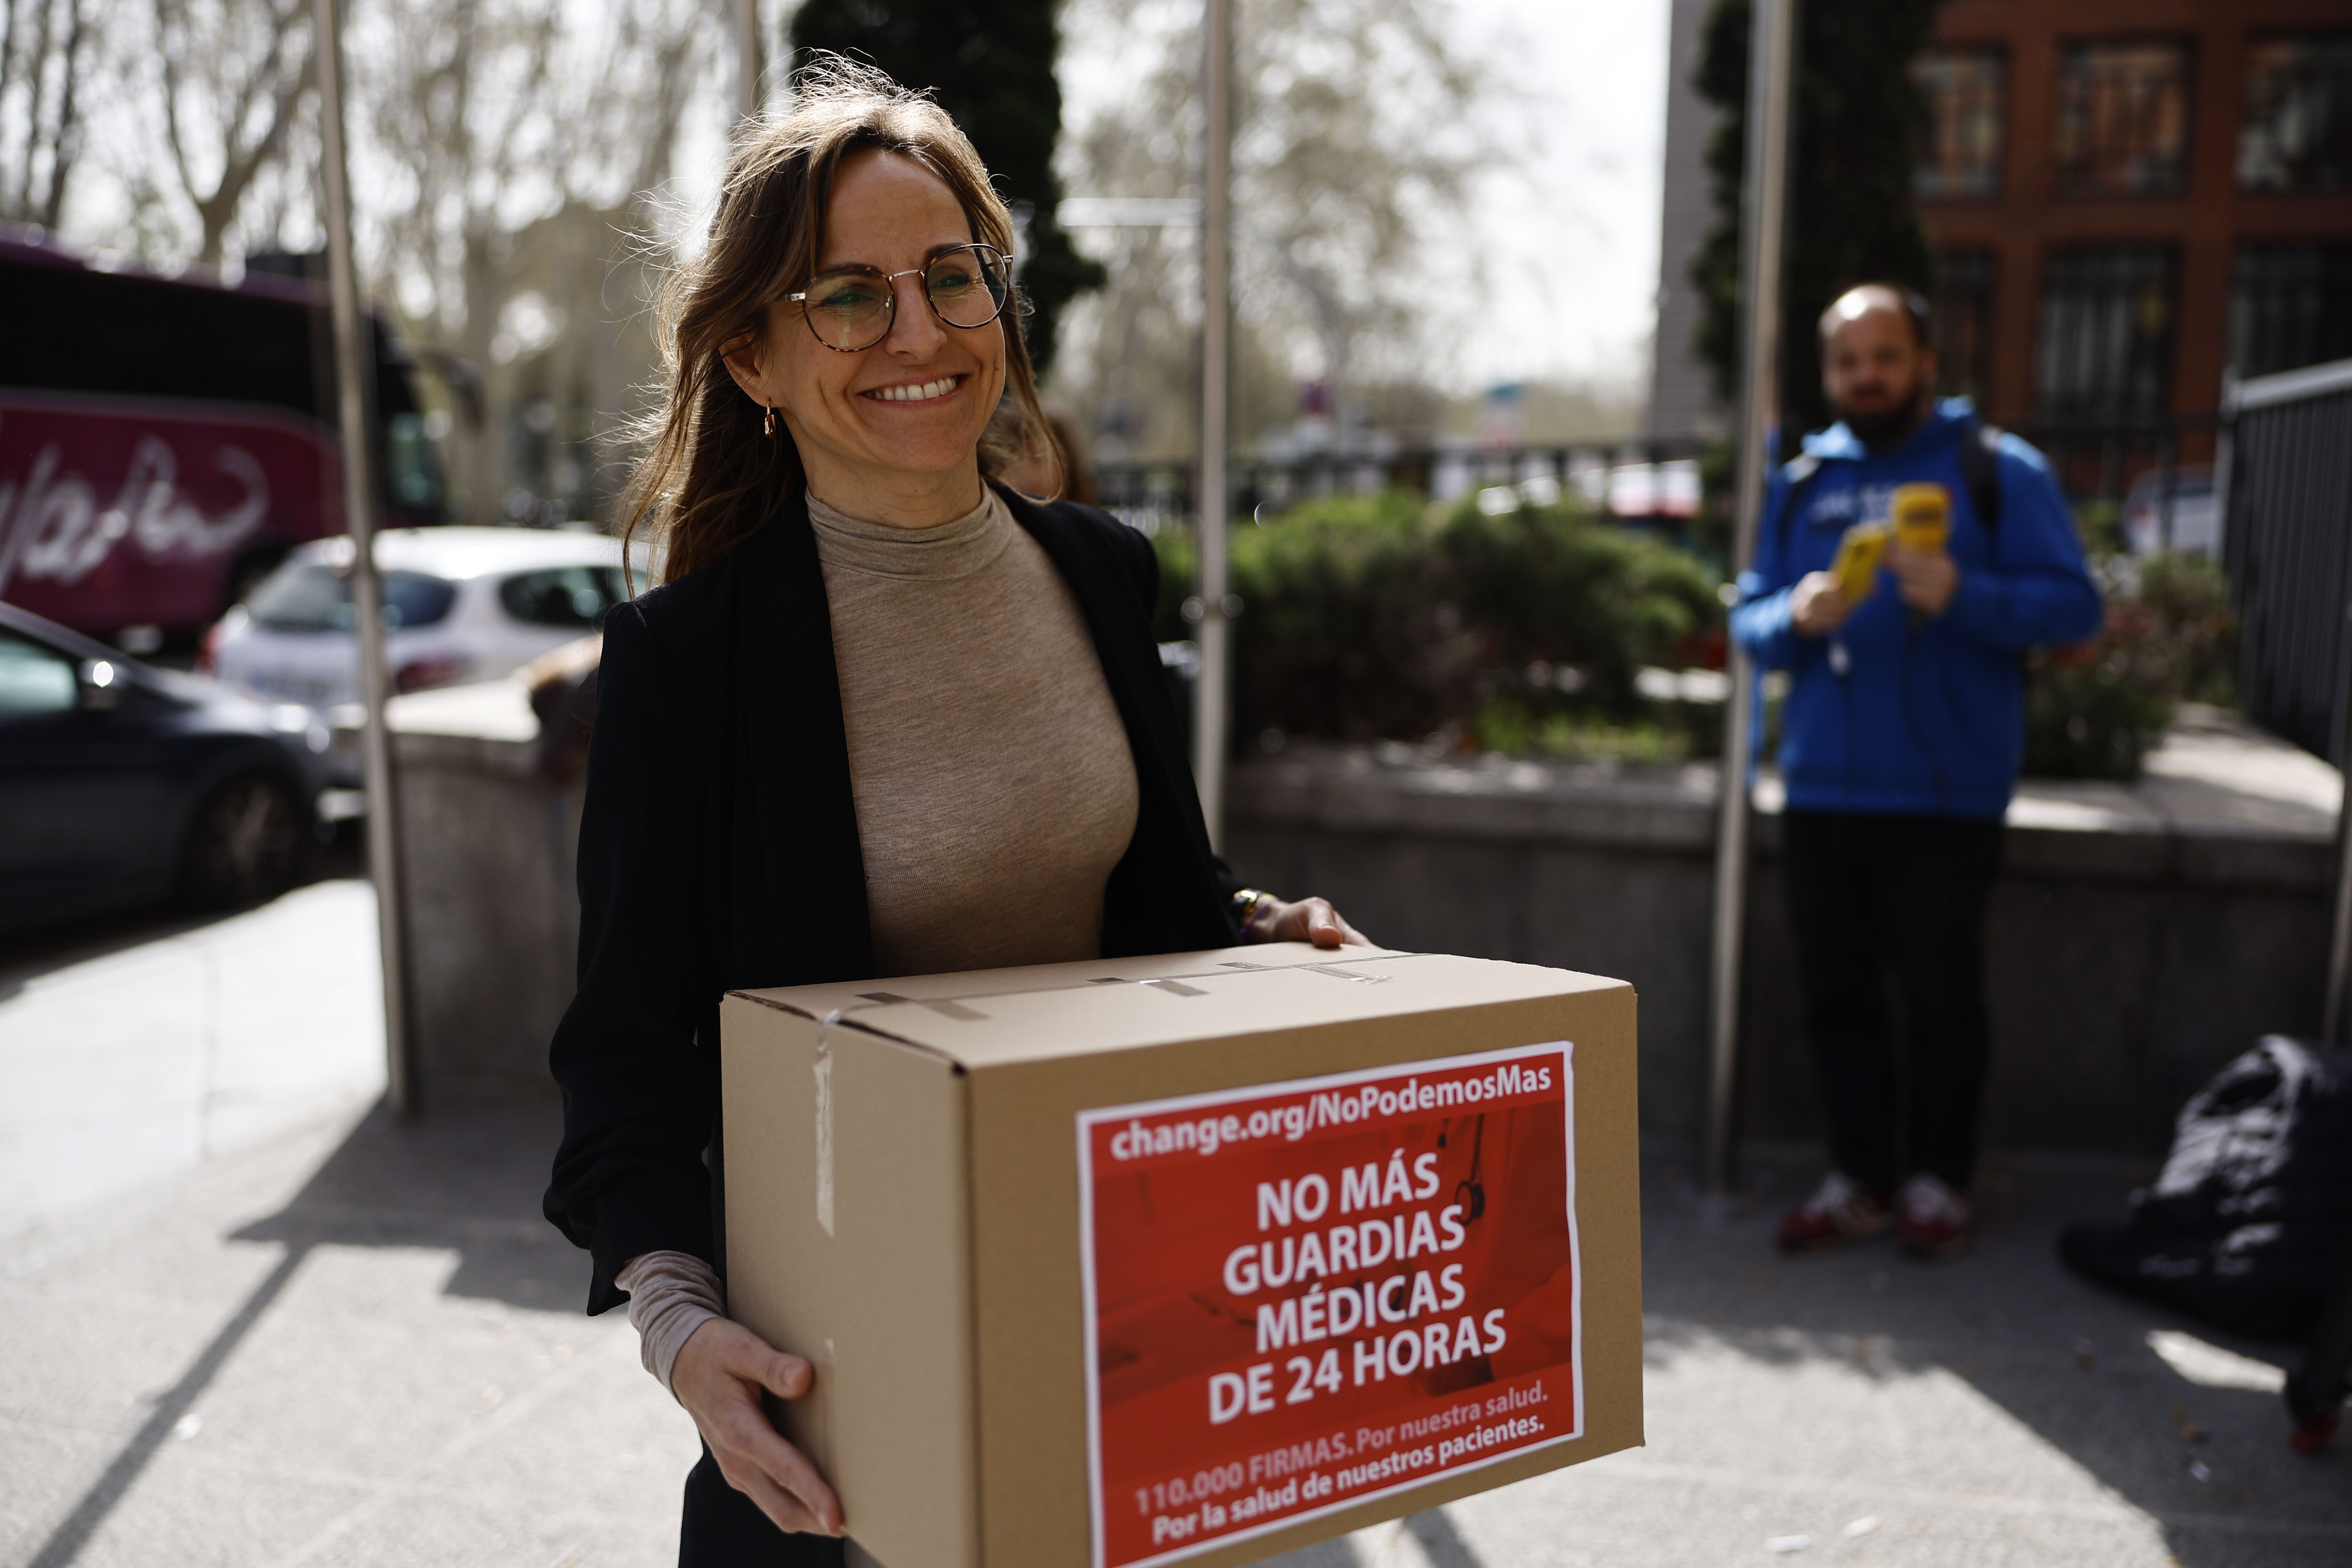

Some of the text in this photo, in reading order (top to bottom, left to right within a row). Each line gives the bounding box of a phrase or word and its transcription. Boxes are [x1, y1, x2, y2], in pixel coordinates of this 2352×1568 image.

[1110, 1065, 1551, 1160] change.org/NoPodemosMas
[1256, 1147, 1440, 1231] NO MÁS
[1223, 1204, 1465, 1294] GUARDIAS
[1256, 1263, 1465, 1354] MÉDICAS
[1209, 1308, 1507, 1425] DE 24 HORAS
[1134, 1379, 1548, 1516] 110.000 FIRMAS. Por nuestra salud.
[1152, 1414, 1545, 1545] Por la salud de nuestros pacientes.
